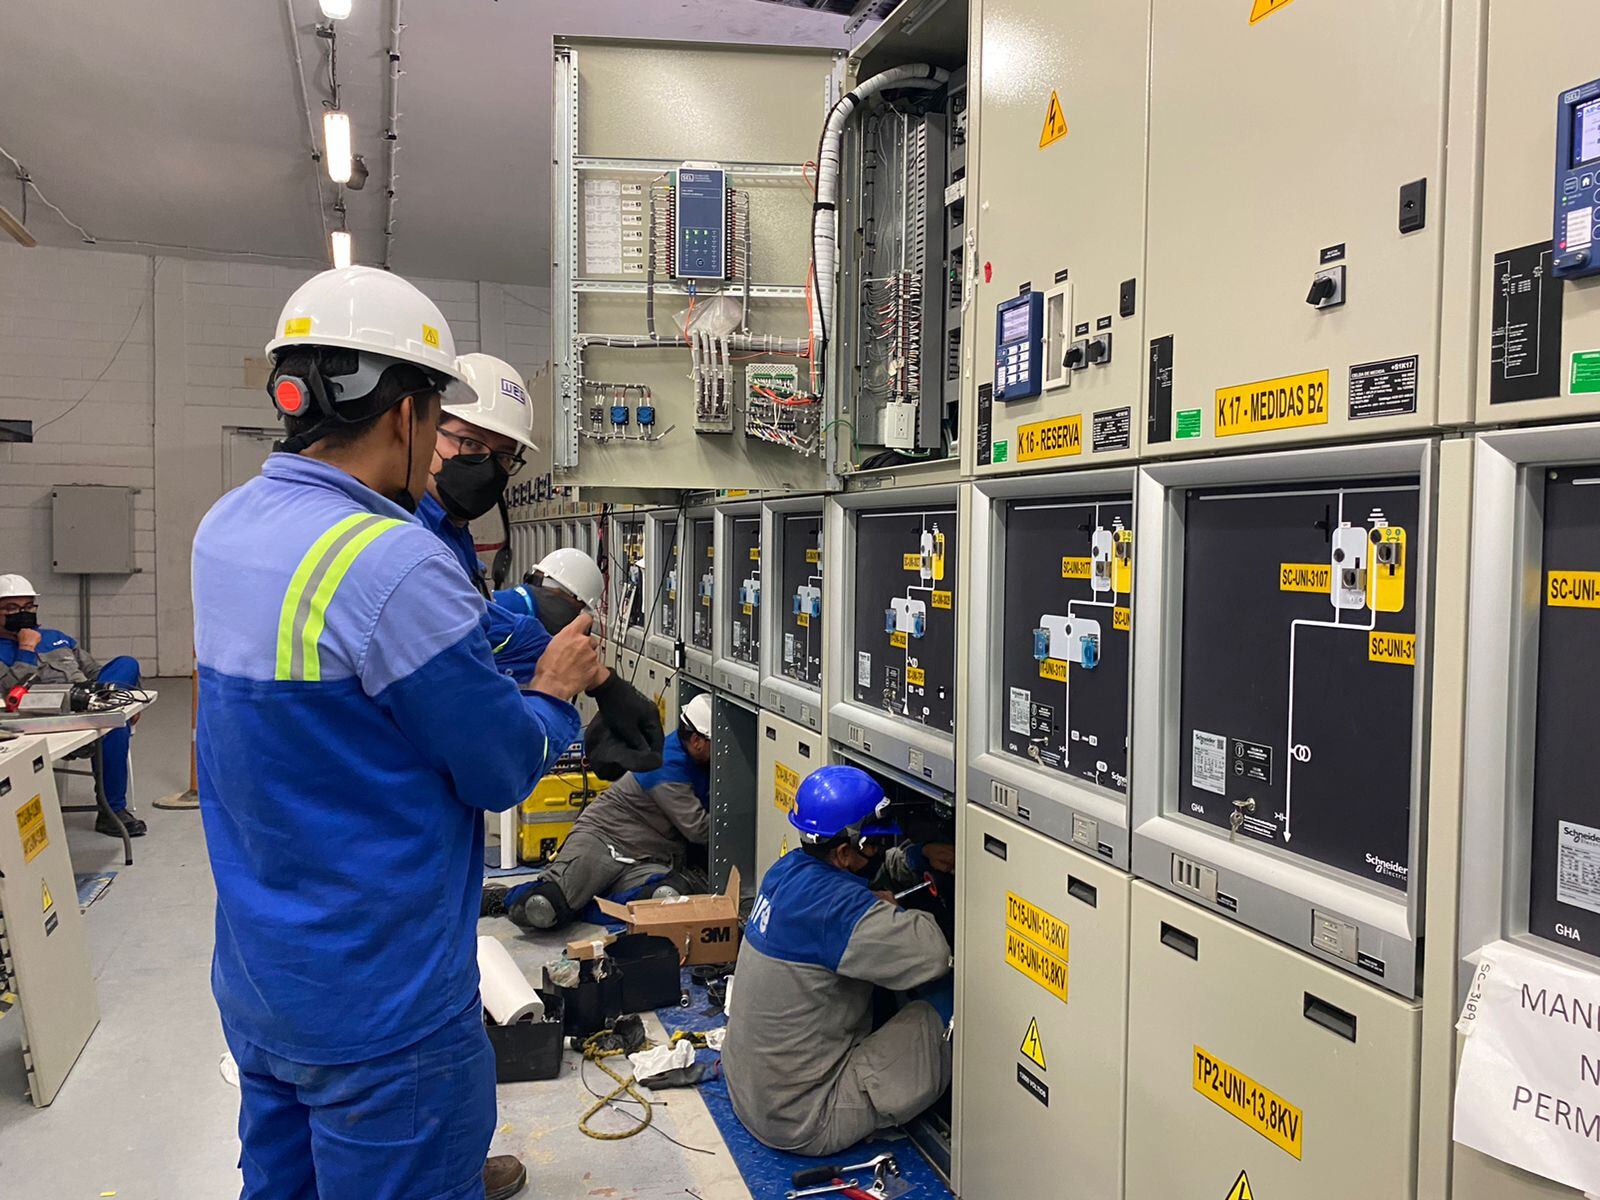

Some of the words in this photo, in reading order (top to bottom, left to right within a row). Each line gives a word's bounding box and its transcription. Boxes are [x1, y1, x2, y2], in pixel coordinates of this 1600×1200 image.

[1218, 398, 1226, 426] K
[1230, 396, 1240, 424] 17
[1251, 385, 1304, 422] MEDIDAS
[1308, 382, 1323, 414] B2
[1018, 432, 1024, 454] K
[1026, 431, 1034, 453] 16
[1040, 423, 1080, 451] RESERVA
[1282, 569, 1328, 588] SC-UNI-3107
[1551, 578, 1600, 600] SC-UNI-
[1191, 803, 1204, 814] GHA
[1366, 853, 1408, 874] Schneider
[701, 927, 730, 943] 3M
[1008, 897, 1066, 950] TC15-UNI-13,8KV
[1555, 923, 1580, 941] GHA
[1008, 935, 1066, 990] AV15-UNI-13,8KV
[1463, 964, 1490, 1020] SC-3189
[1196, 1052, 1298, 1141] TP2-UNI-13,8KV
[1512, 1086, 1600, 1142] PERM
